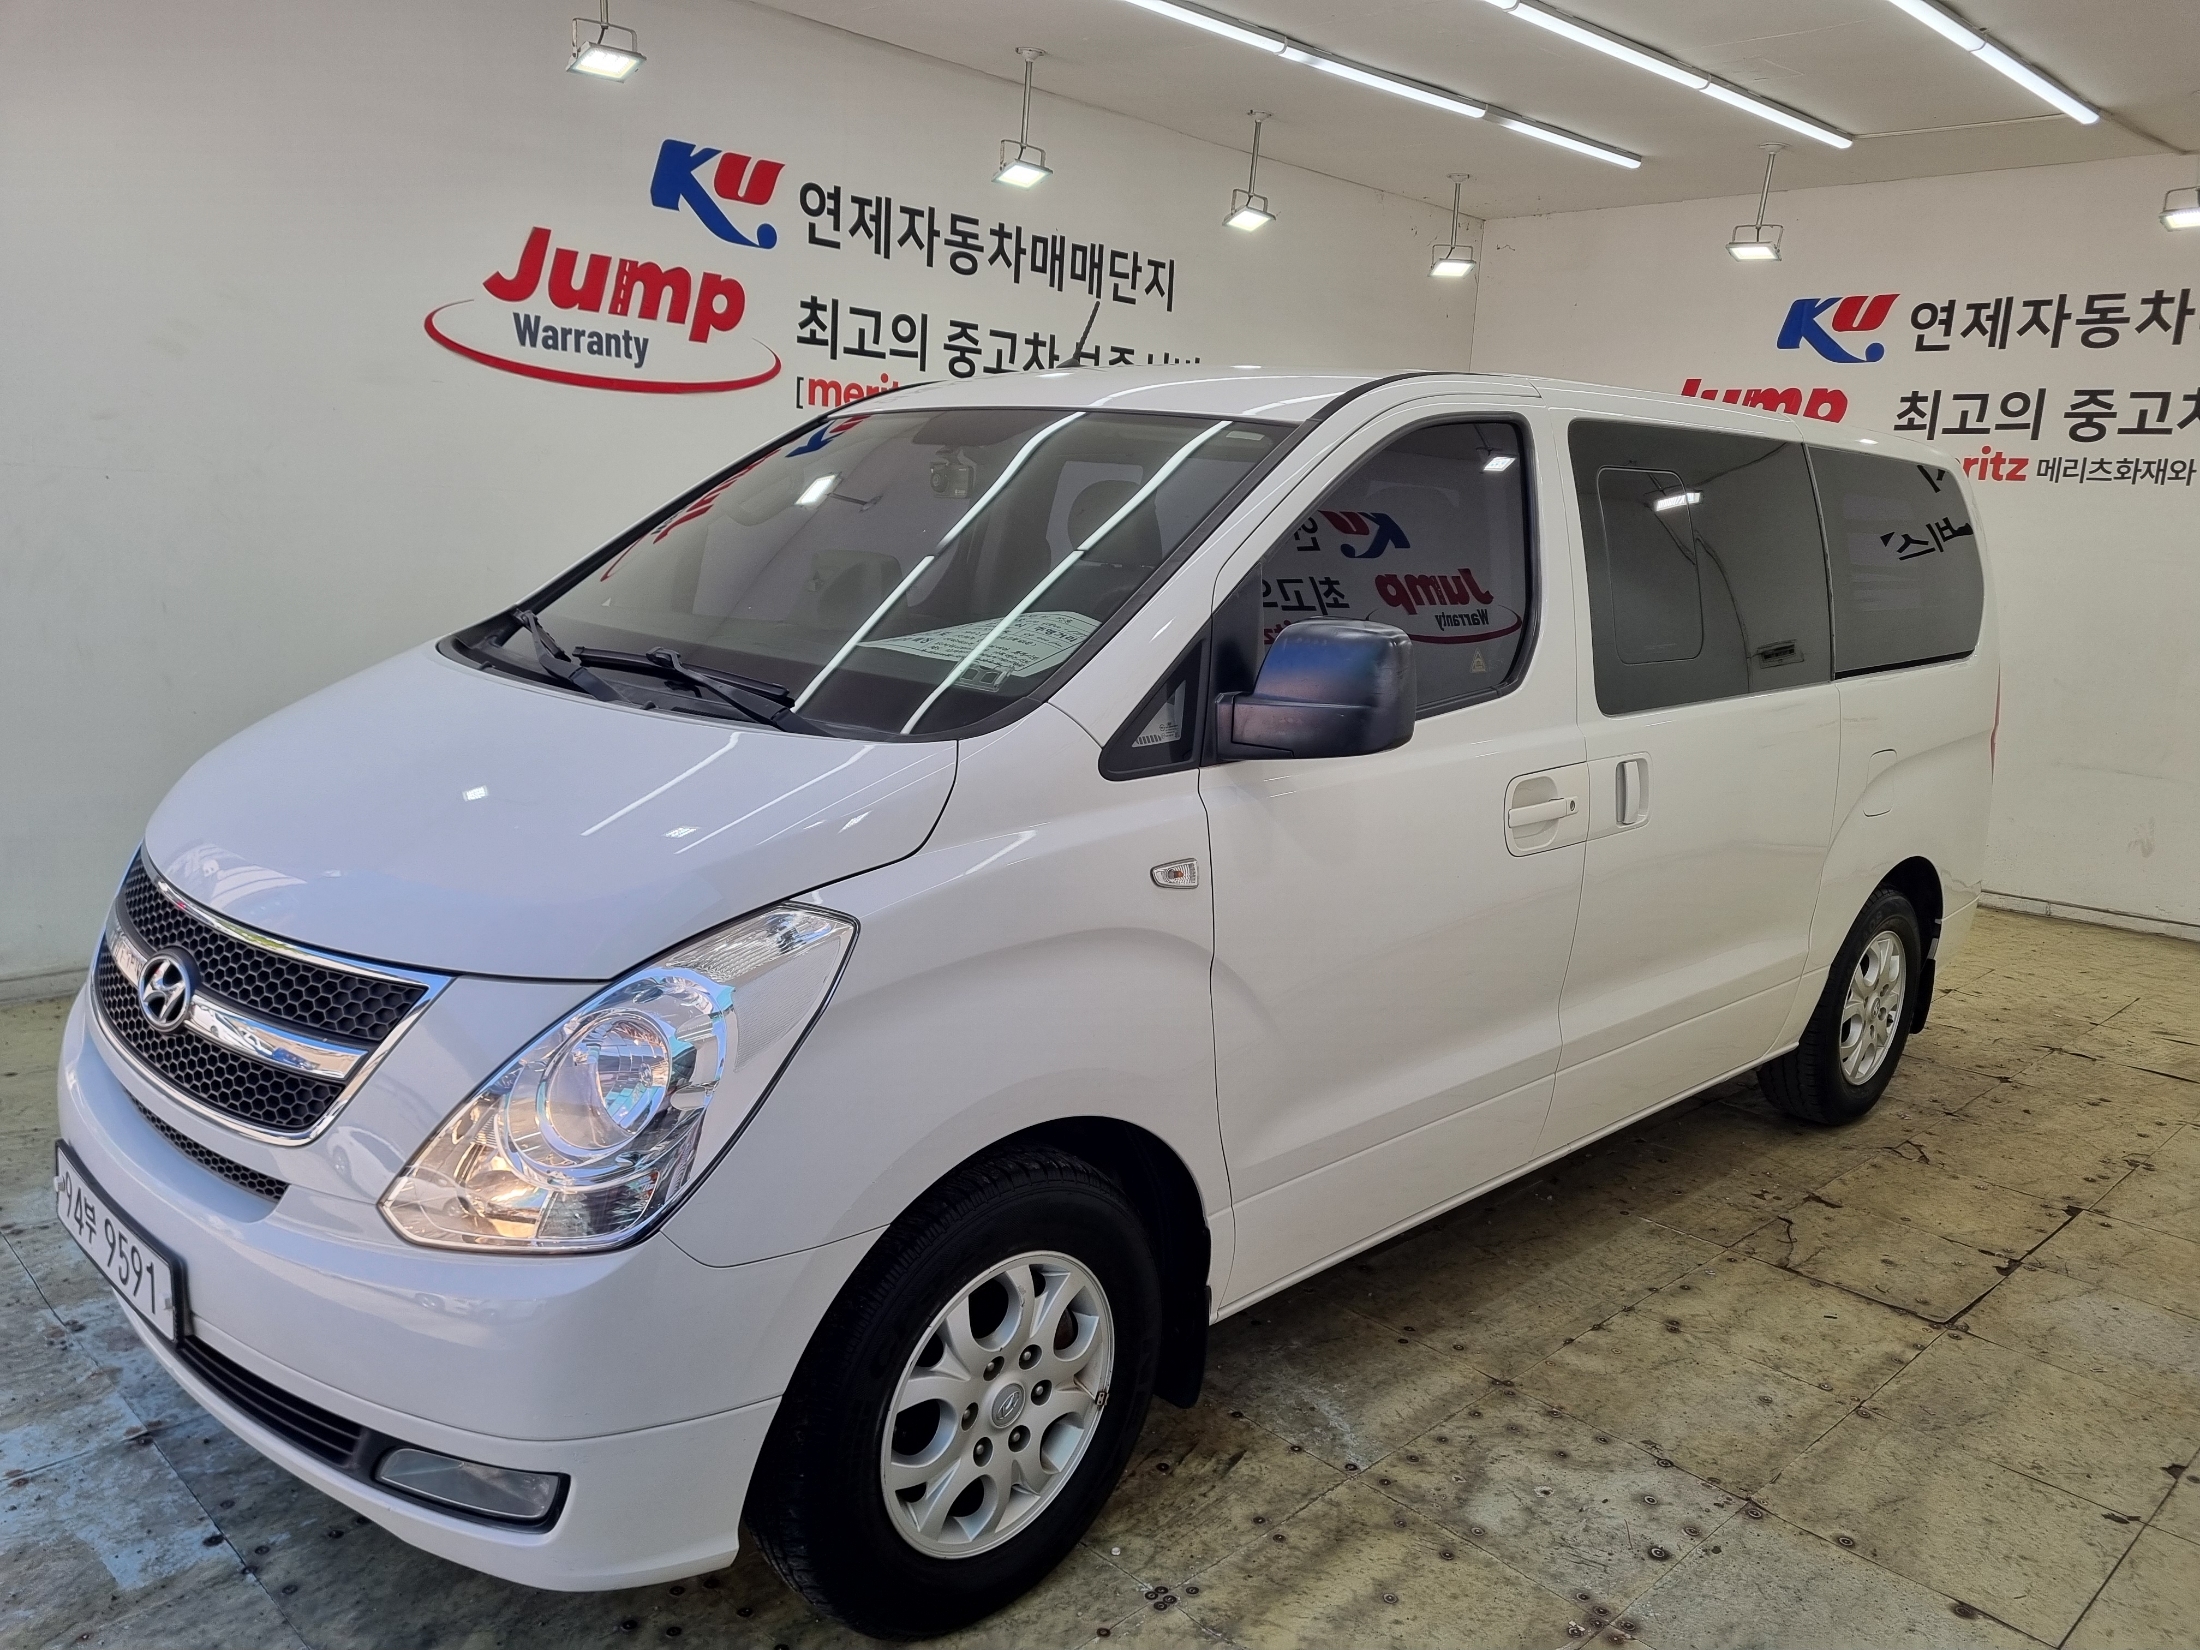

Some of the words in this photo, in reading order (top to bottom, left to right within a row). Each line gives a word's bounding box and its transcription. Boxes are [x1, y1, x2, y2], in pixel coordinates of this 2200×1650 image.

[798, 182, 1177, 312] 연제자동차매매단지
[483, 226, 746, 343] Jump
[1909, 287, 2200, 352] 연제자동차
[512, 312, 649, 369] Warranty
[797, 295, 929, 372] 최고의
[943, 320, 1060, 377] 중고차
[1894, 388, 2047, 440] 최고의
[2036, 456, 2198, 487] 메리츠화재와
[104, 1218, 156, 1315] 9591
